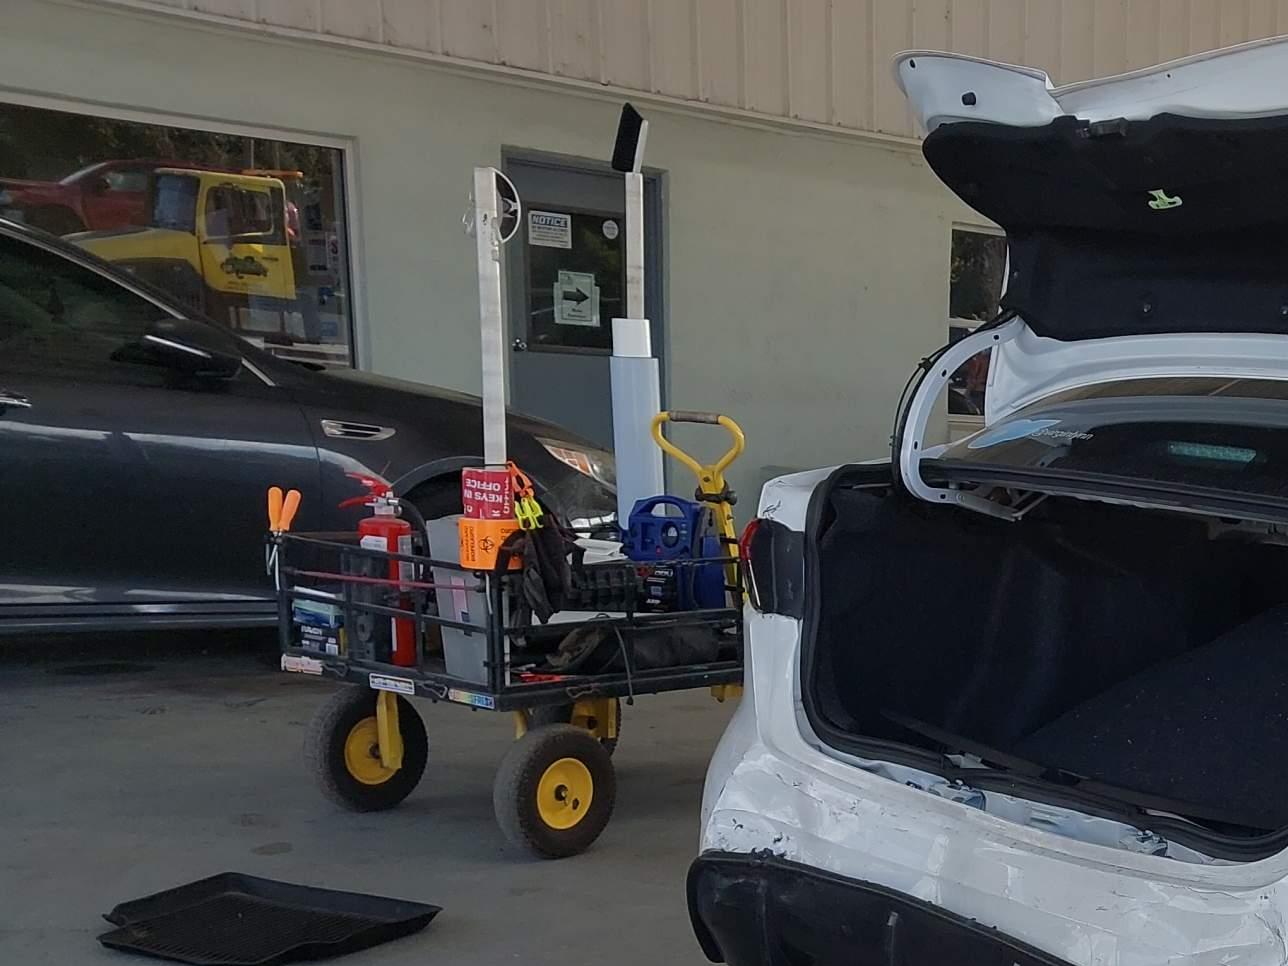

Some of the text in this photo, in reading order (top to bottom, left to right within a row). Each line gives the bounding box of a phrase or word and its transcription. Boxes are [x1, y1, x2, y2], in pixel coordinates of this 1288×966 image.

[532, 215, 567, 227] NOTICE
[466, 479, 501, 492] OFFICE
[474, 491, 503, 503] KEYS
